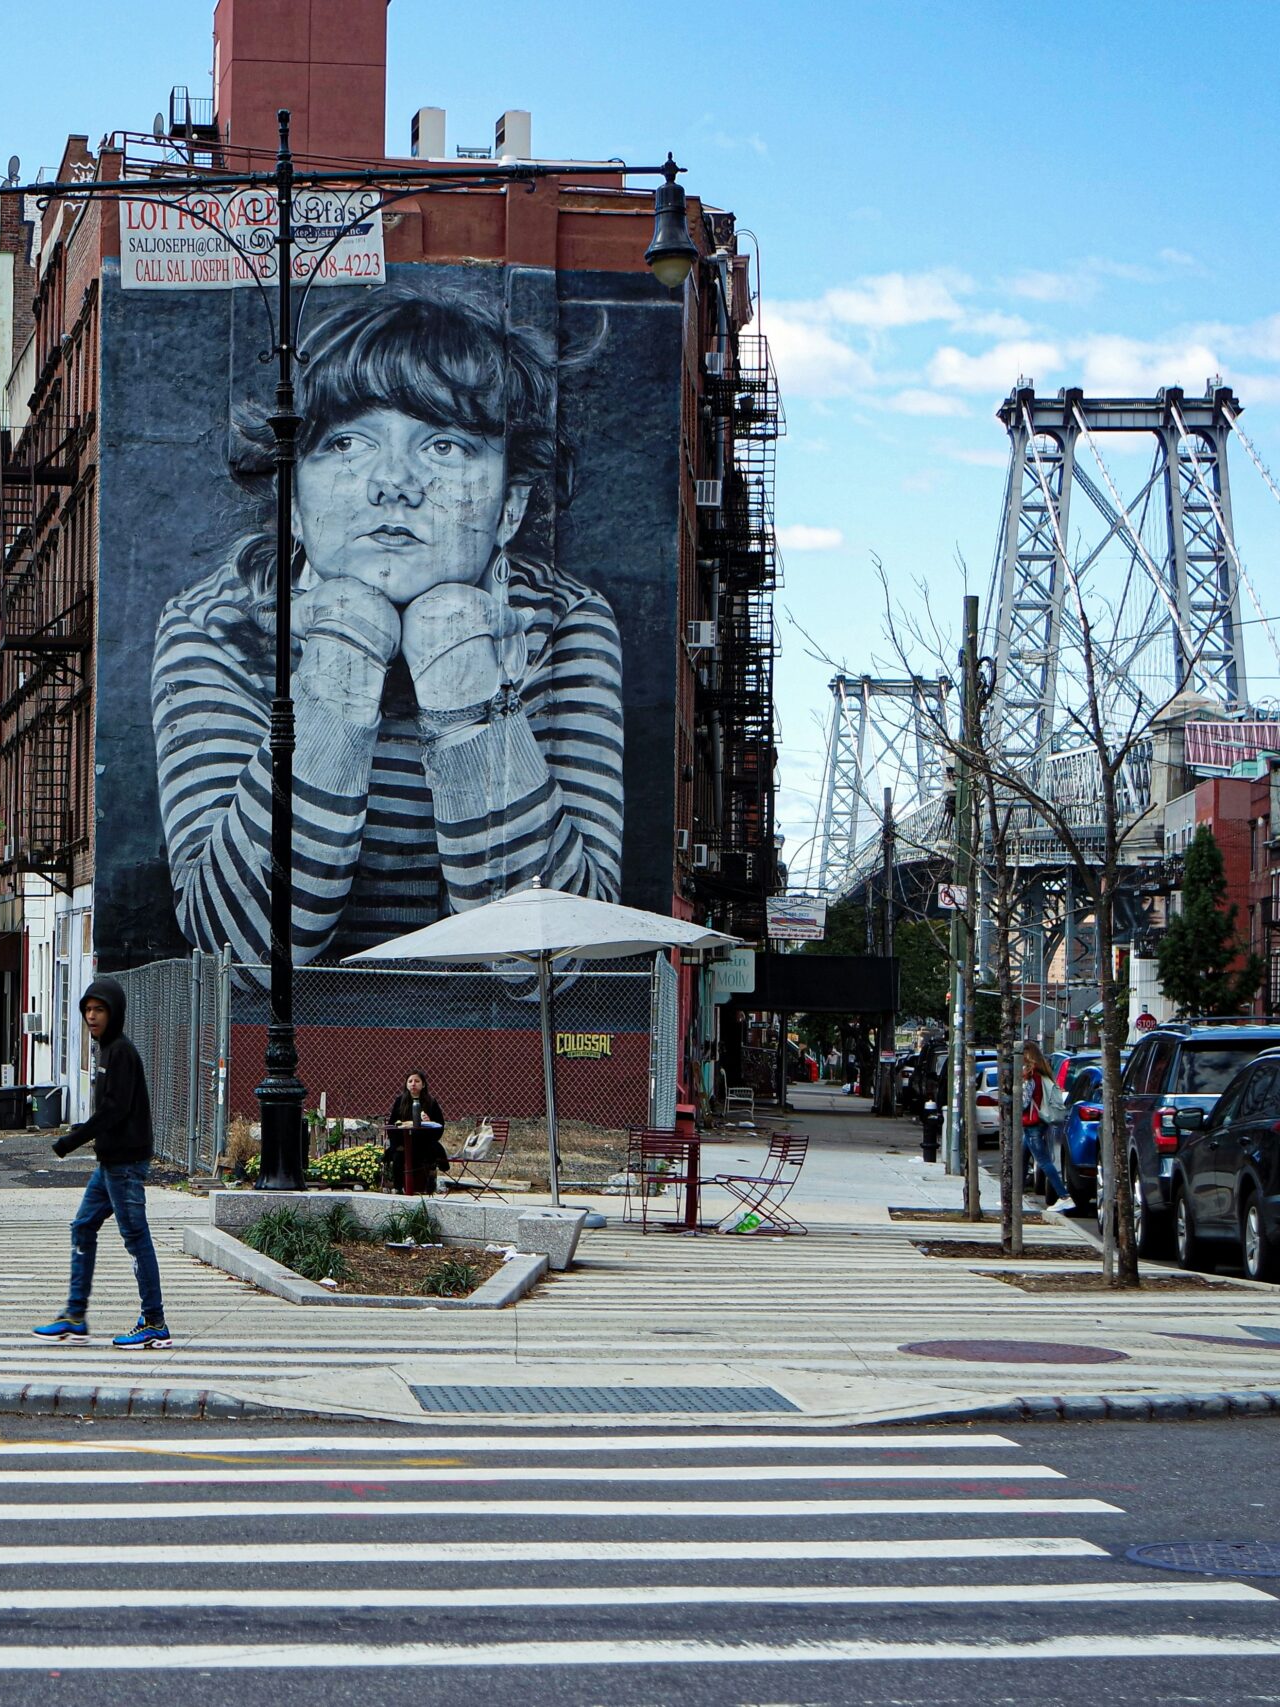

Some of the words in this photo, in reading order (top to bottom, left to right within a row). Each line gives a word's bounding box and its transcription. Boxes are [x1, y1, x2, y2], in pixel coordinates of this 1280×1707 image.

[126, 200, 170, 231] LOT
[177, 200, 223, 231] FOR
[229, 197, 279, 229] SALE
[291, 199, 366, 224] Crifasi
[136, 259, 165, 282] CALL
[167, 259, 188, 282] SAL
[191, 258, 231, 282] JOSEPH
[231, 255, 269, 280] RIFASI
[289, 252, 381, 279] 18-908-4223
[717, 970, 750, 988] Molly
[1137, 1019, 1157, 1028] STOP
[556, 1033, 612, 1056] COLOSSAL
